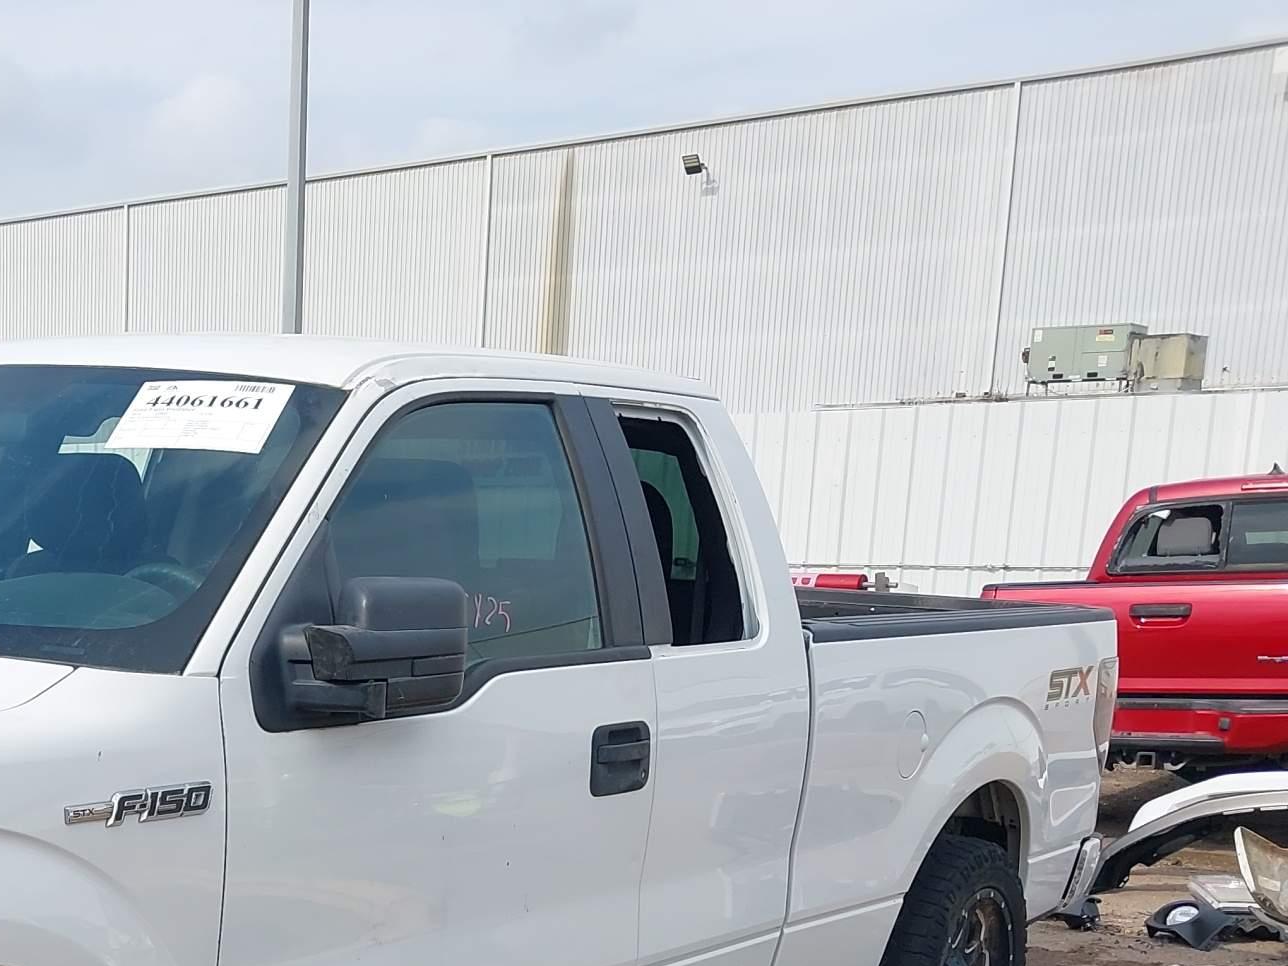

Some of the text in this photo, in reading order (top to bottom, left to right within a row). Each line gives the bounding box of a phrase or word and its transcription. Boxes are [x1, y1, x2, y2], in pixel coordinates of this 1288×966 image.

[146, 394, 264, 410] 44061661
[1047, 665, 1094, 702] STX
[72, 808, 95, 818] STX
